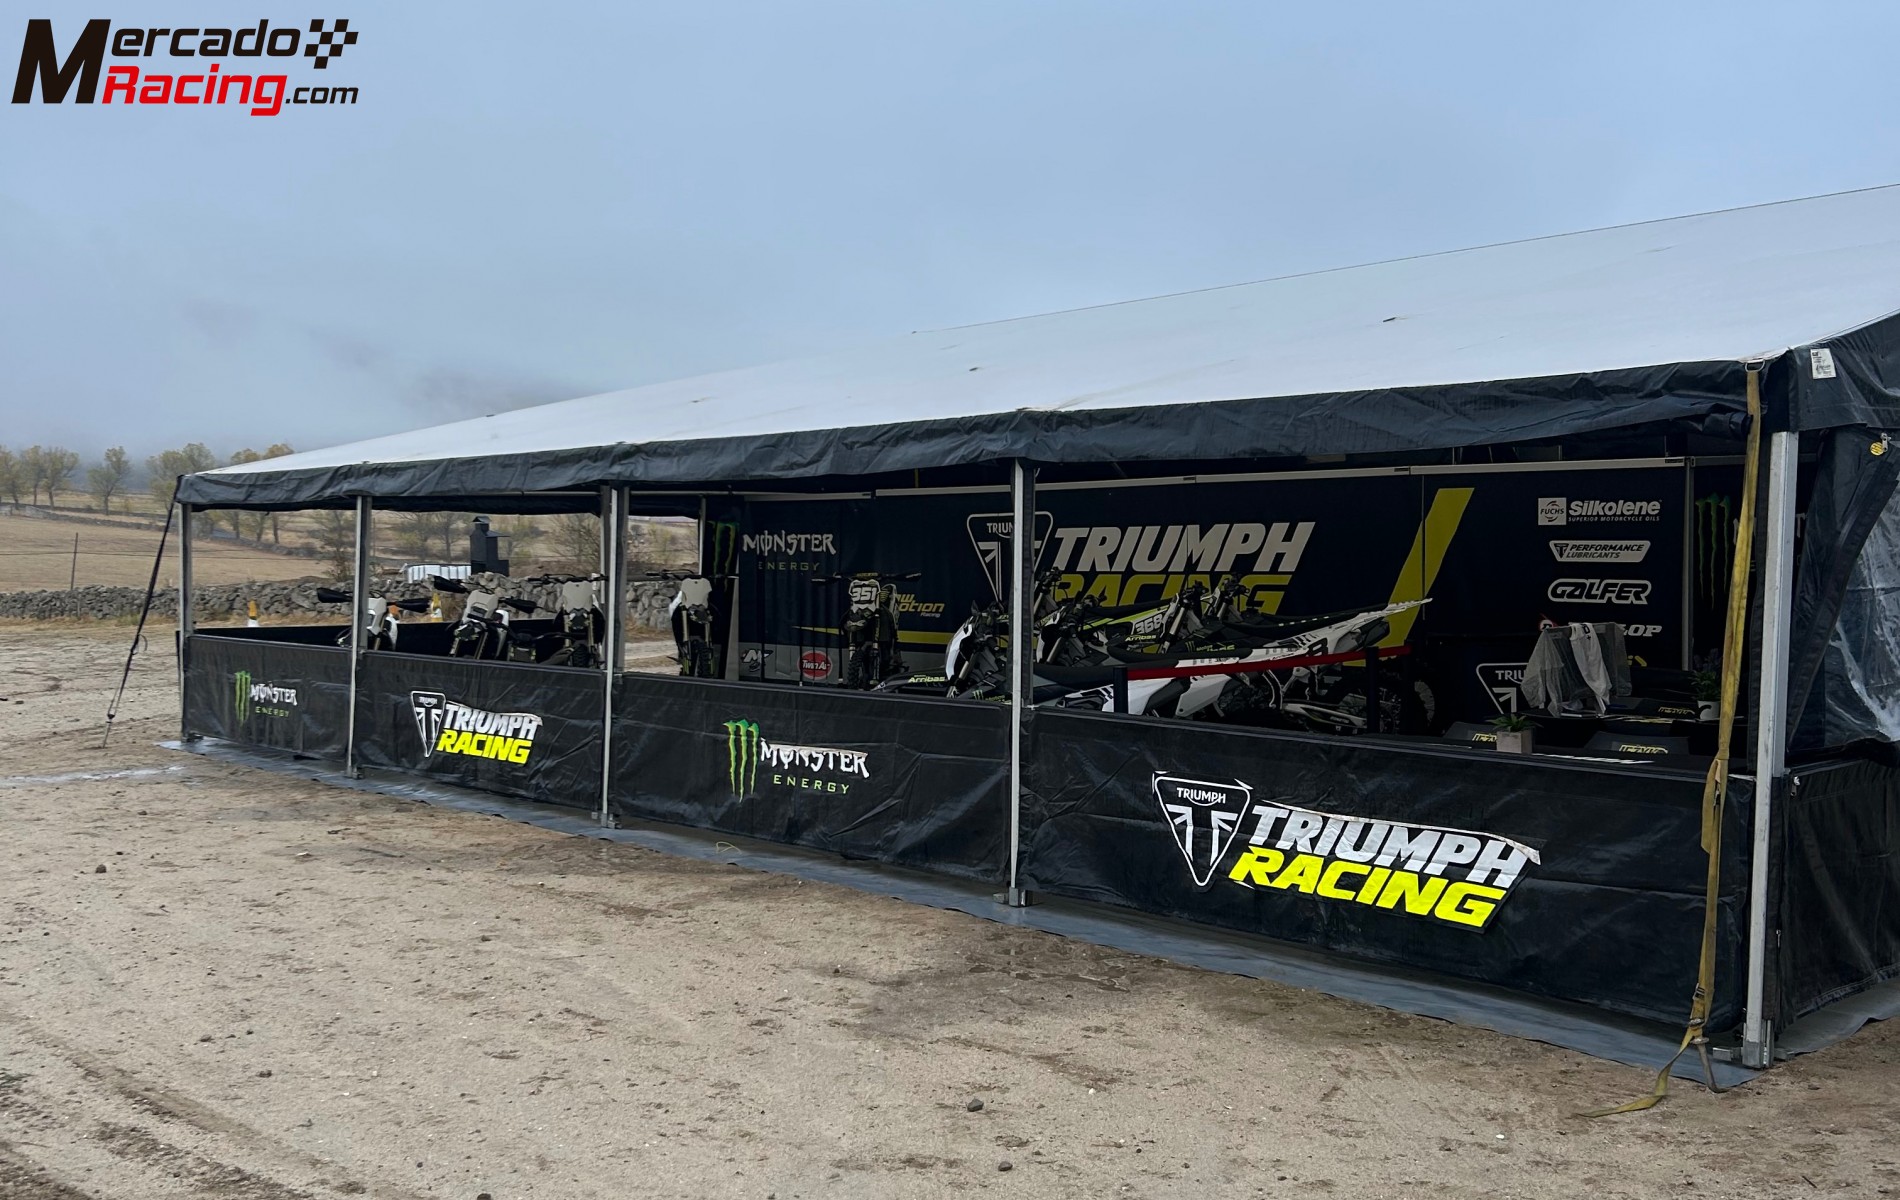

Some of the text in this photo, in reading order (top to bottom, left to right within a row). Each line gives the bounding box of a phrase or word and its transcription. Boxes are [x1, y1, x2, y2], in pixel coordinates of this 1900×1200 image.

[1569, 499, 1661, 515] Silkolene
[986, 522, 1014, 537] TRIU
[743, 530, 836, 556] MONSTER
[1053, 522, 1316, 572] TRIUMPH
[1570, 544, 1644, 552] PERFORMANCE
[758, 562, 820, 572] ENERGY
[851, 586, 877, 602] 351
[1549, 580, 1650, 603] GALFER
[898, 600, 946, 612] otion
[1135, 614, 1162, 634] 368
[1494, 670, 1525, 684] TRIU
[250, 681, 298, 706] MONSTER
[255, 706, 290, 717] ENERGY
[444, 703, 538, 741] TRIUMPH
[436, 728, 534, 764] RACING
[760, 737, 870, 778] MONSTER
[773, 774, 850, 794] ENERGY
[1176, 787, 1226, 806] TRIUMPH
[1251, 804, 1532, 888] TRIUMPH
[1228, 846, 1507, 928] RACING
